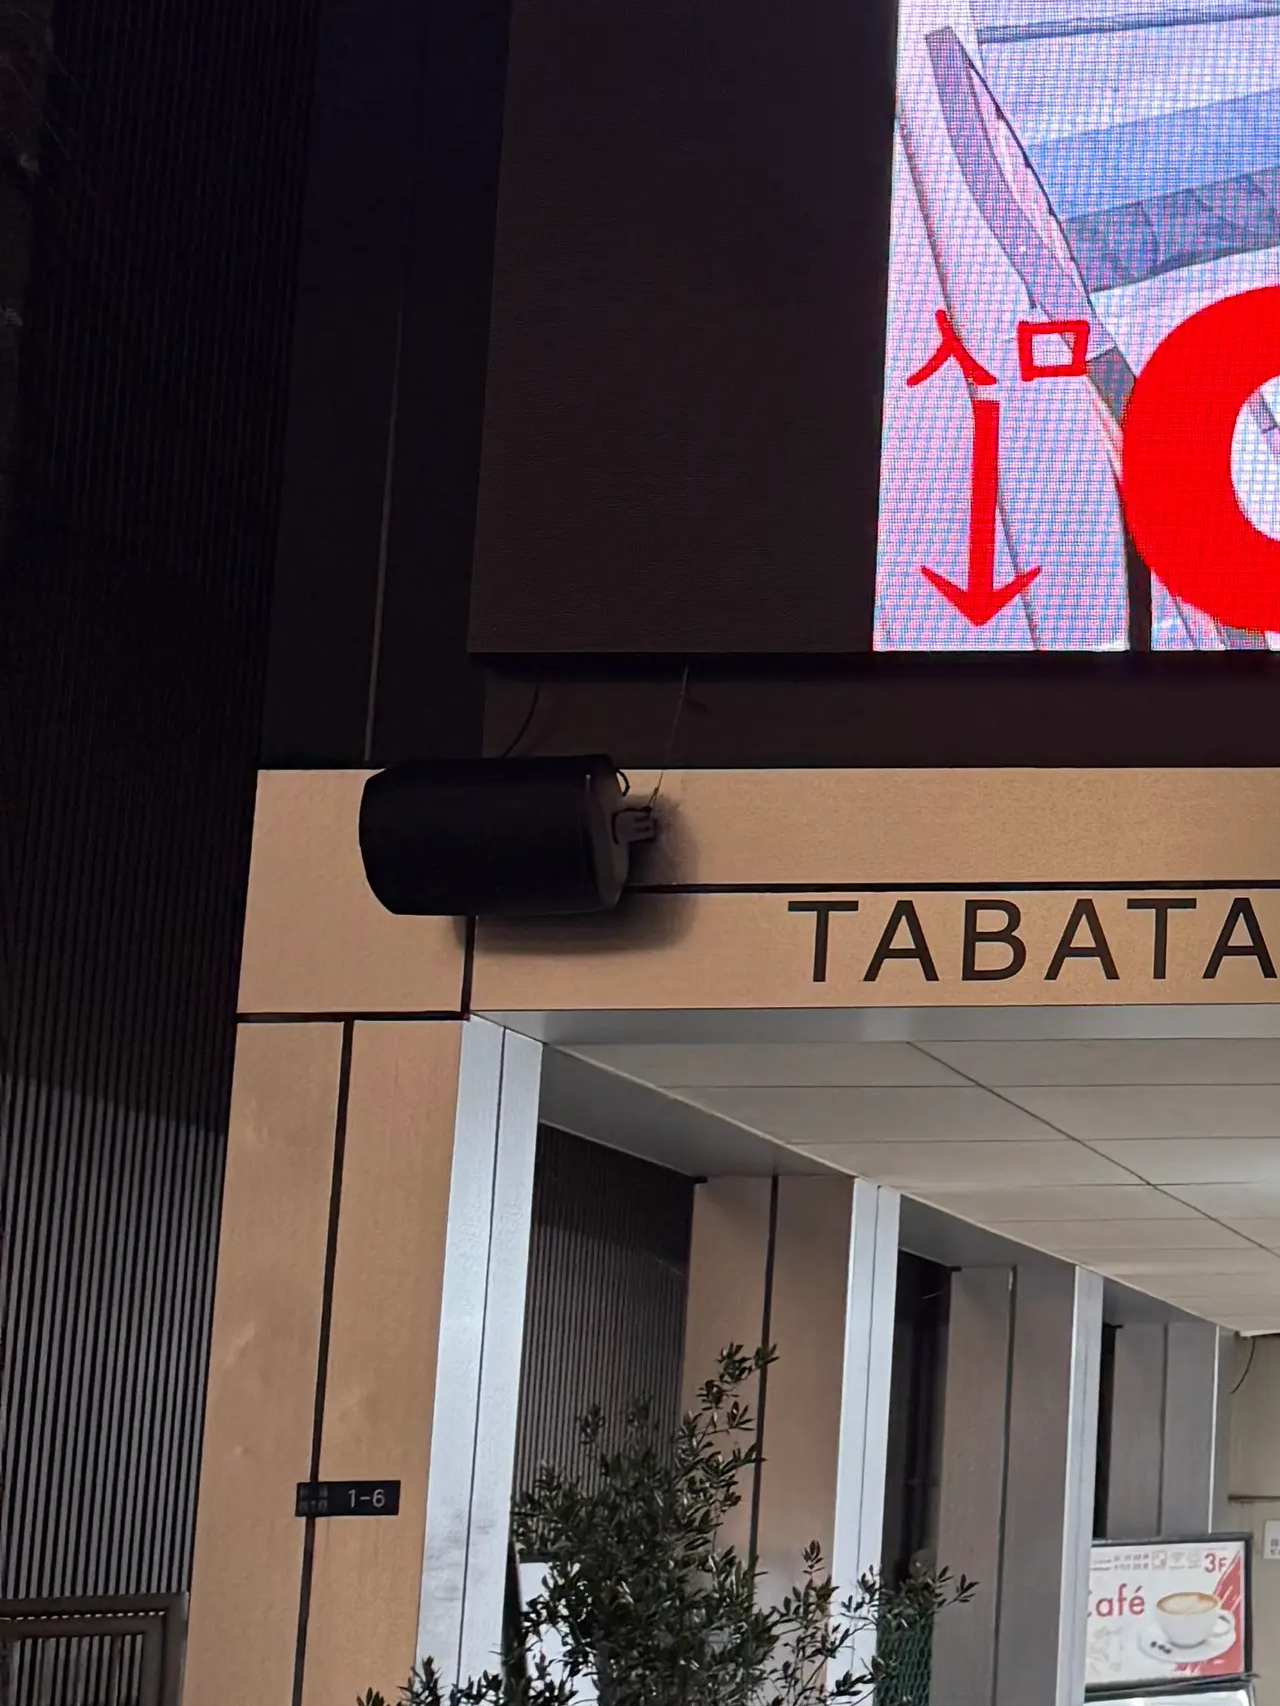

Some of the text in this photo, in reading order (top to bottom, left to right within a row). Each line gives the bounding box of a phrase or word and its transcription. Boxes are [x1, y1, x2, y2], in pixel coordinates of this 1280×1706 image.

[905, 309, 1091, 388] 入口
[787, 896, 1279, 983] TABATA
[347, 1488, 386, 1509] 1-6
[1204, 1552, 1229, 1574] 3F
[1087, 1582, 1146, 1618] afé
